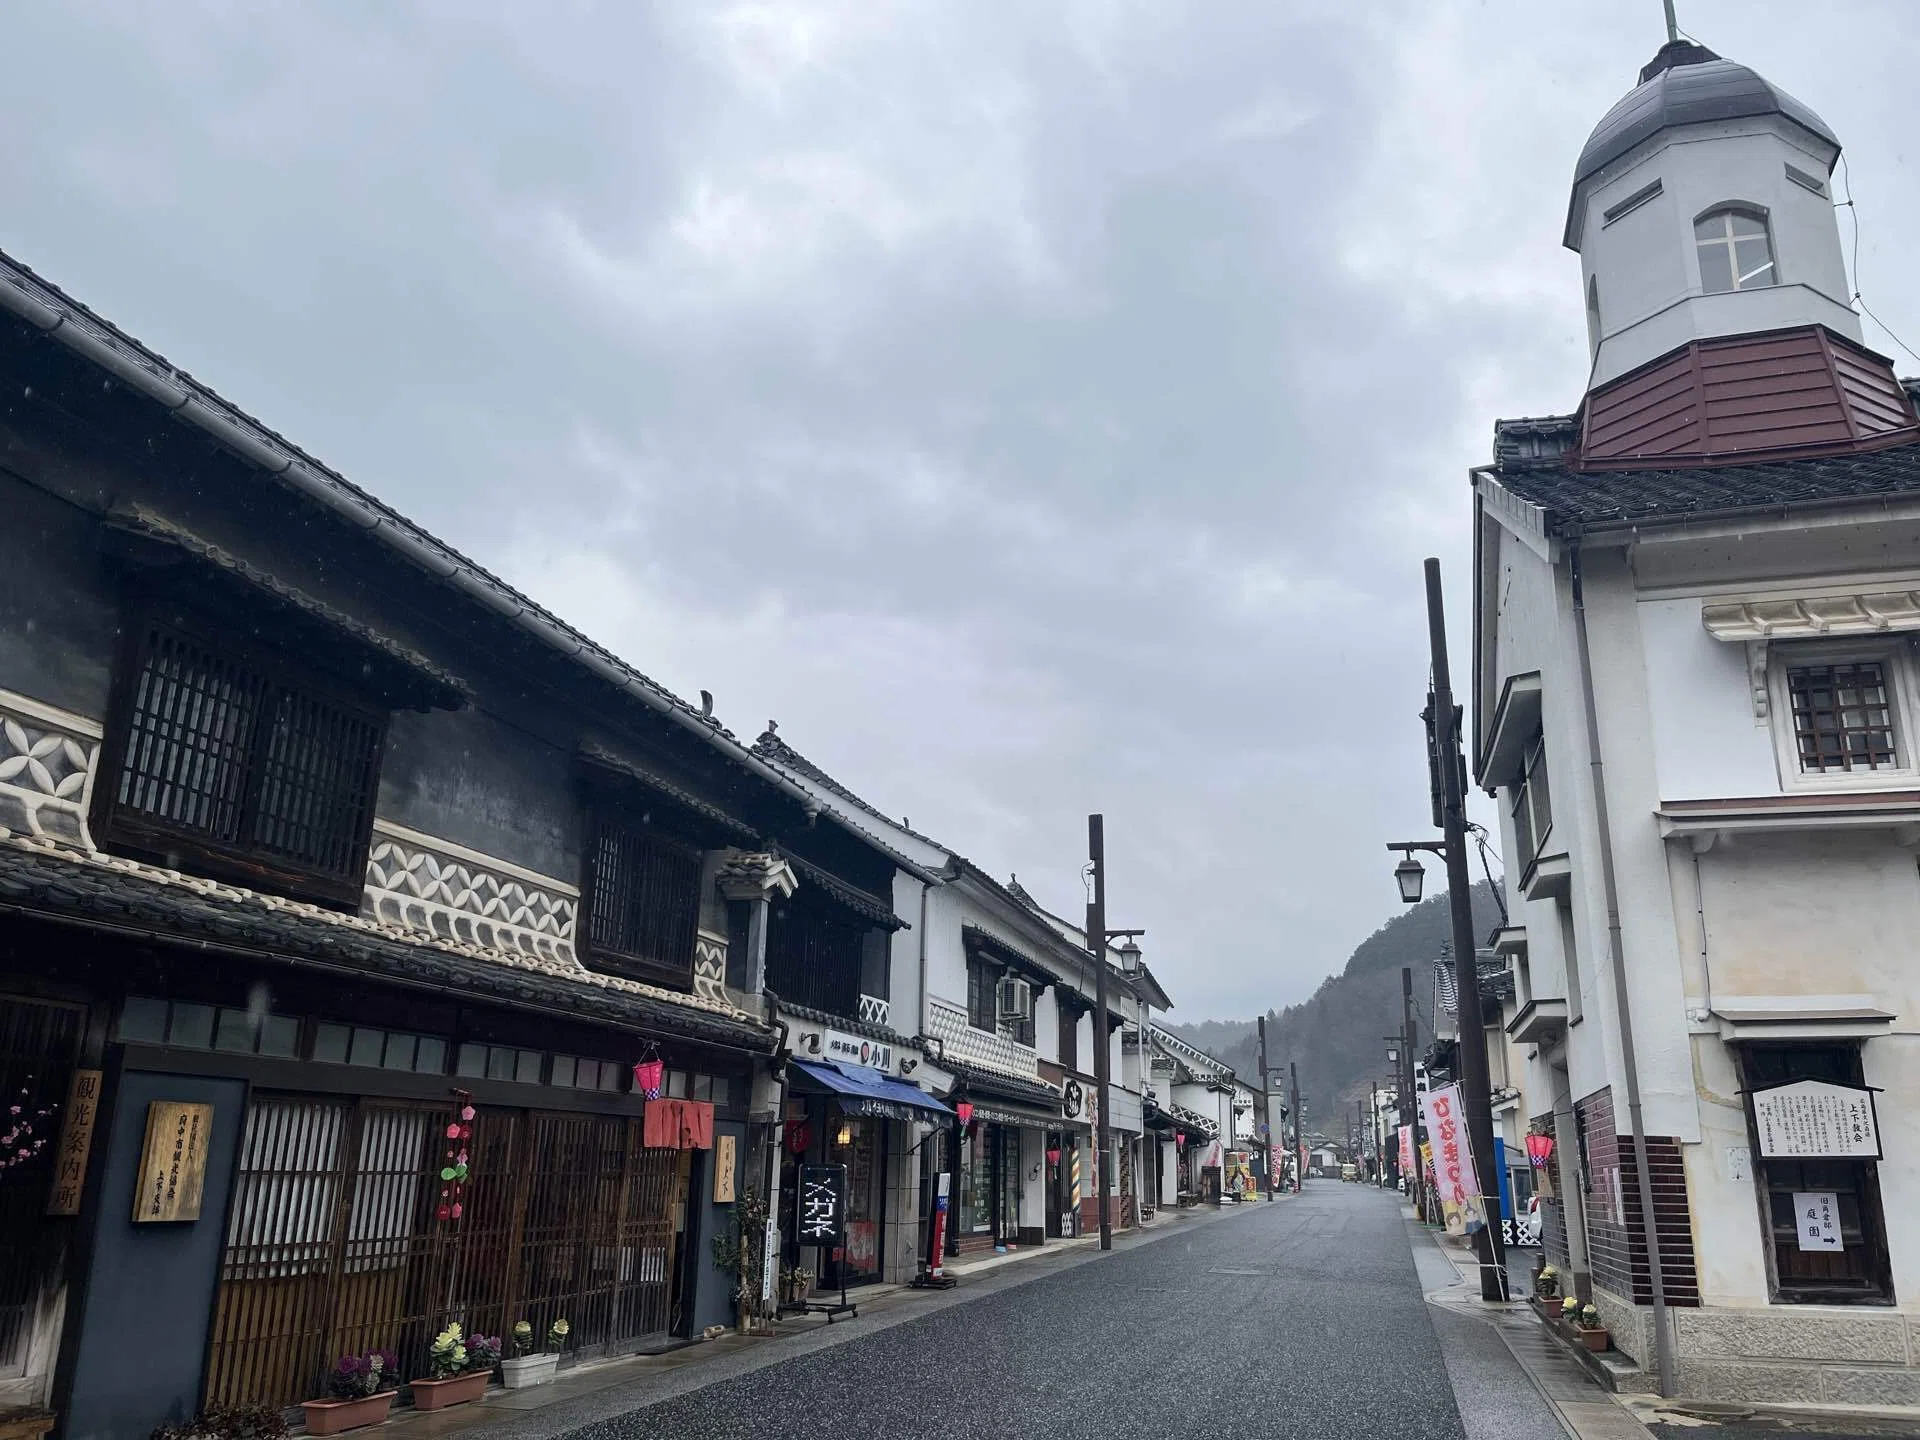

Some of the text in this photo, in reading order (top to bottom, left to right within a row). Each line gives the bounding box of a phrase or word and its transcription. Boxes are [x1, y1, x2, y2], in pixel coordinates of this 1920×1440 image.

[870, 1044, 891, 1069] 小川
[56, 1077, 97, 1208] 観光案内所
[1433, 1097, 1466, 1206] ひなまつり
[1850, 1103, 1863, 1143] 上下教会
[167, 1113, 188, 1200] 府中市観光協会
[801, 1177, 837, 1238] メガネ
[1806, 1208, 1820, 1238] 庭園
